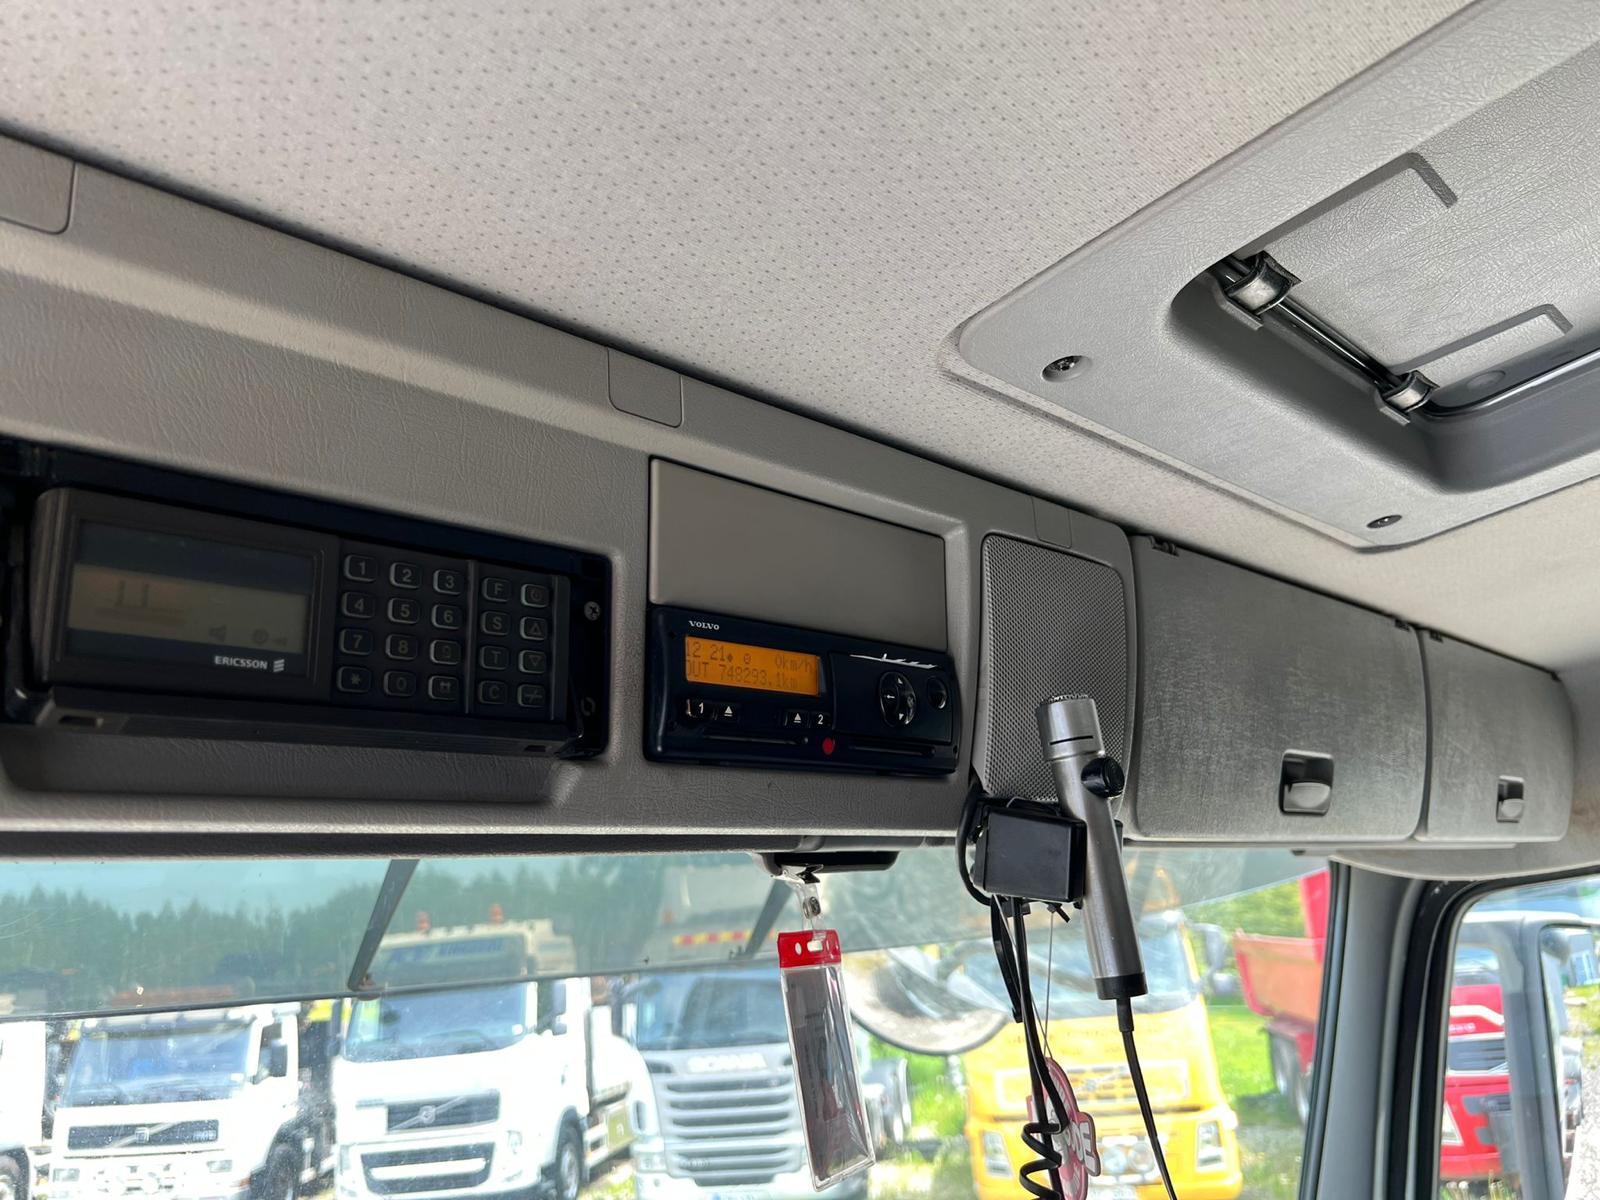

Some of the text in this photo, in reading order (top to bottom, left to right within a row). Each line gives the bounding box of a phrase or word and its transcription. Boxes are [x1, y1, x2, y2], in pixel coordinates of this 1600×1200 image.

[358, 562, 367, 576] 1
[402, 569, 412, 583] 2
[445, 576, 454, 589] 3
[494, 583, 503, 595] F
[355, 599, 364, 612] 4
[401, 604, 410, 618] 5
[443, 610, 453, 623] 6
[492, 616, 502, 630] S
[689, 620, 720, 630] VOLVO
[353, 634, 363, 649] 7
[398, 640, 408, 654] 8
[214, 655, 268, 669] ERICSSON
[699, 702, 704, 714] 1
[817, 714, 824, 725] 2
